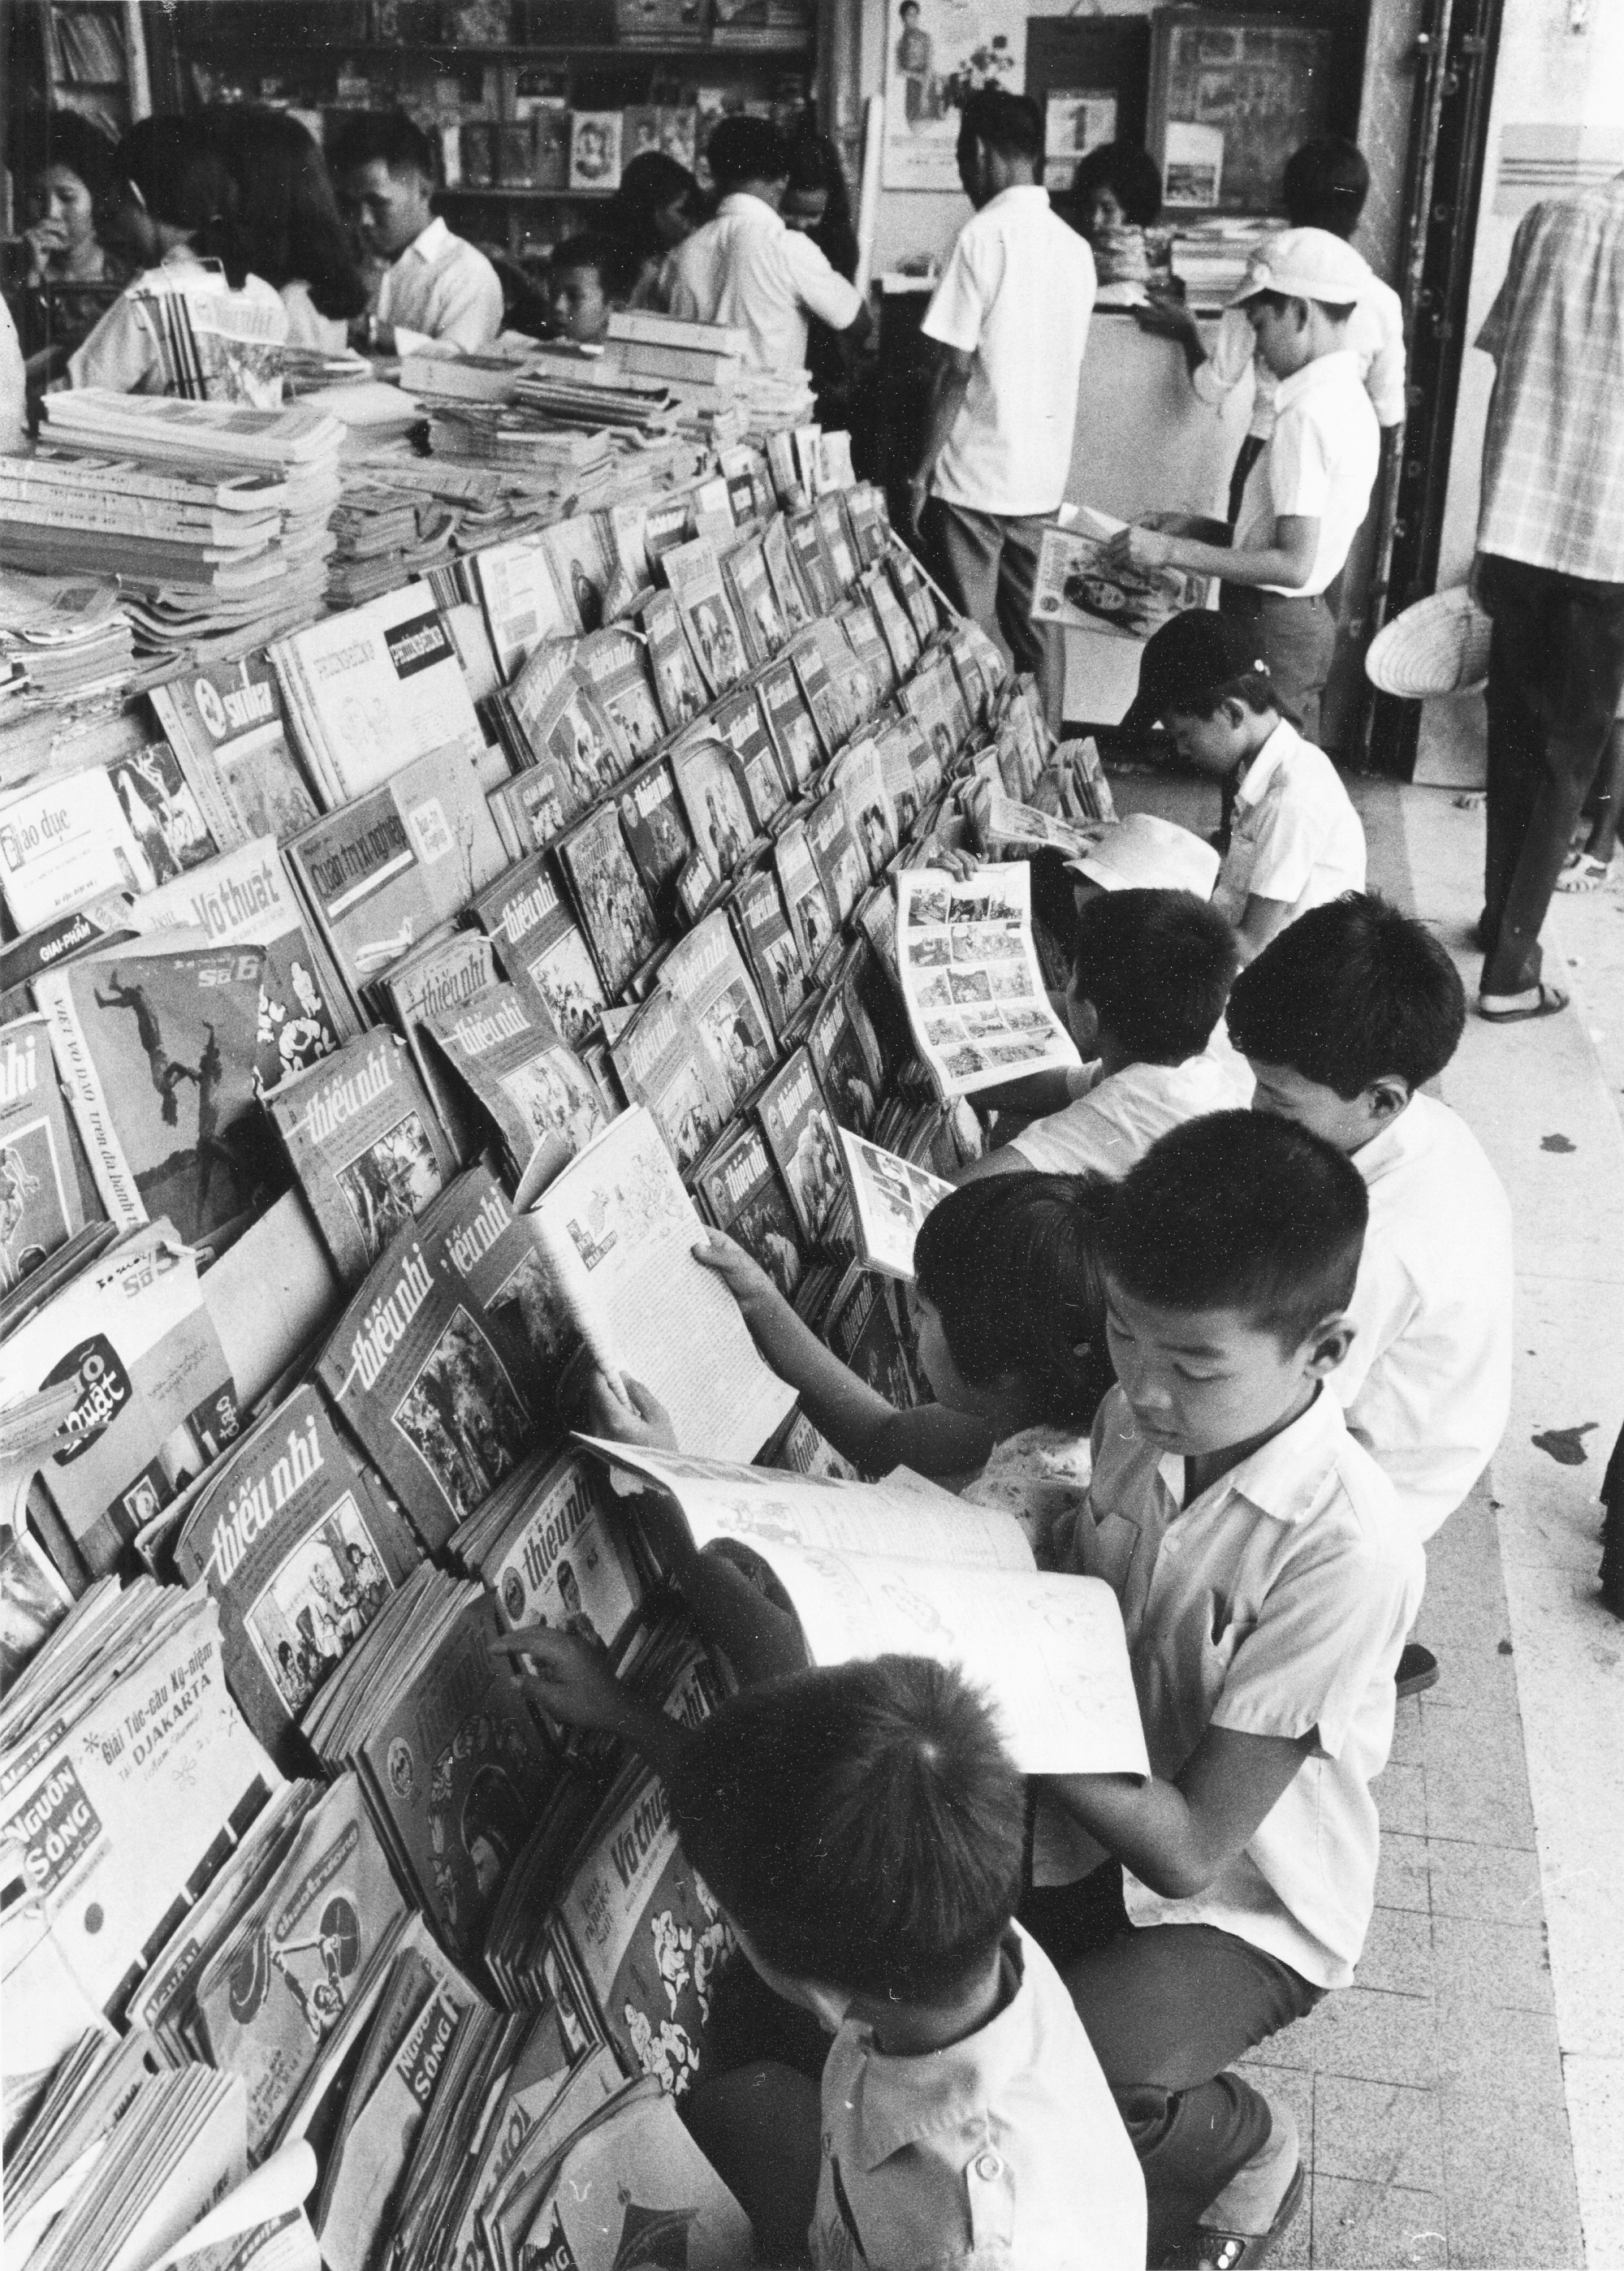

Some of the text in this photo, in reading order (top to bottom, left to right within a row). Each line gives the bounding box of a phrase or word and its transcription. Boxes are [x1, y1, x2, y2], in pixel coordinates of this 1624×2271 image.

[455, 996, 532, 1056] thiếu nhi
[304, 1043, 395, 1144] thiếu nhi
[446, 1185, 512, 1279] iếu nhi
[80, 1344, 105, 1381] õ
[352, 1242, 435, 1391] thiếu nhi
[211, 1475, 274, 1586] thiếu
[270, 1414, 325, 1511] nhi
[132, 1673, 212, 1767] DJAKARTA
[415, 2017, 451, 2101] SỐNG
